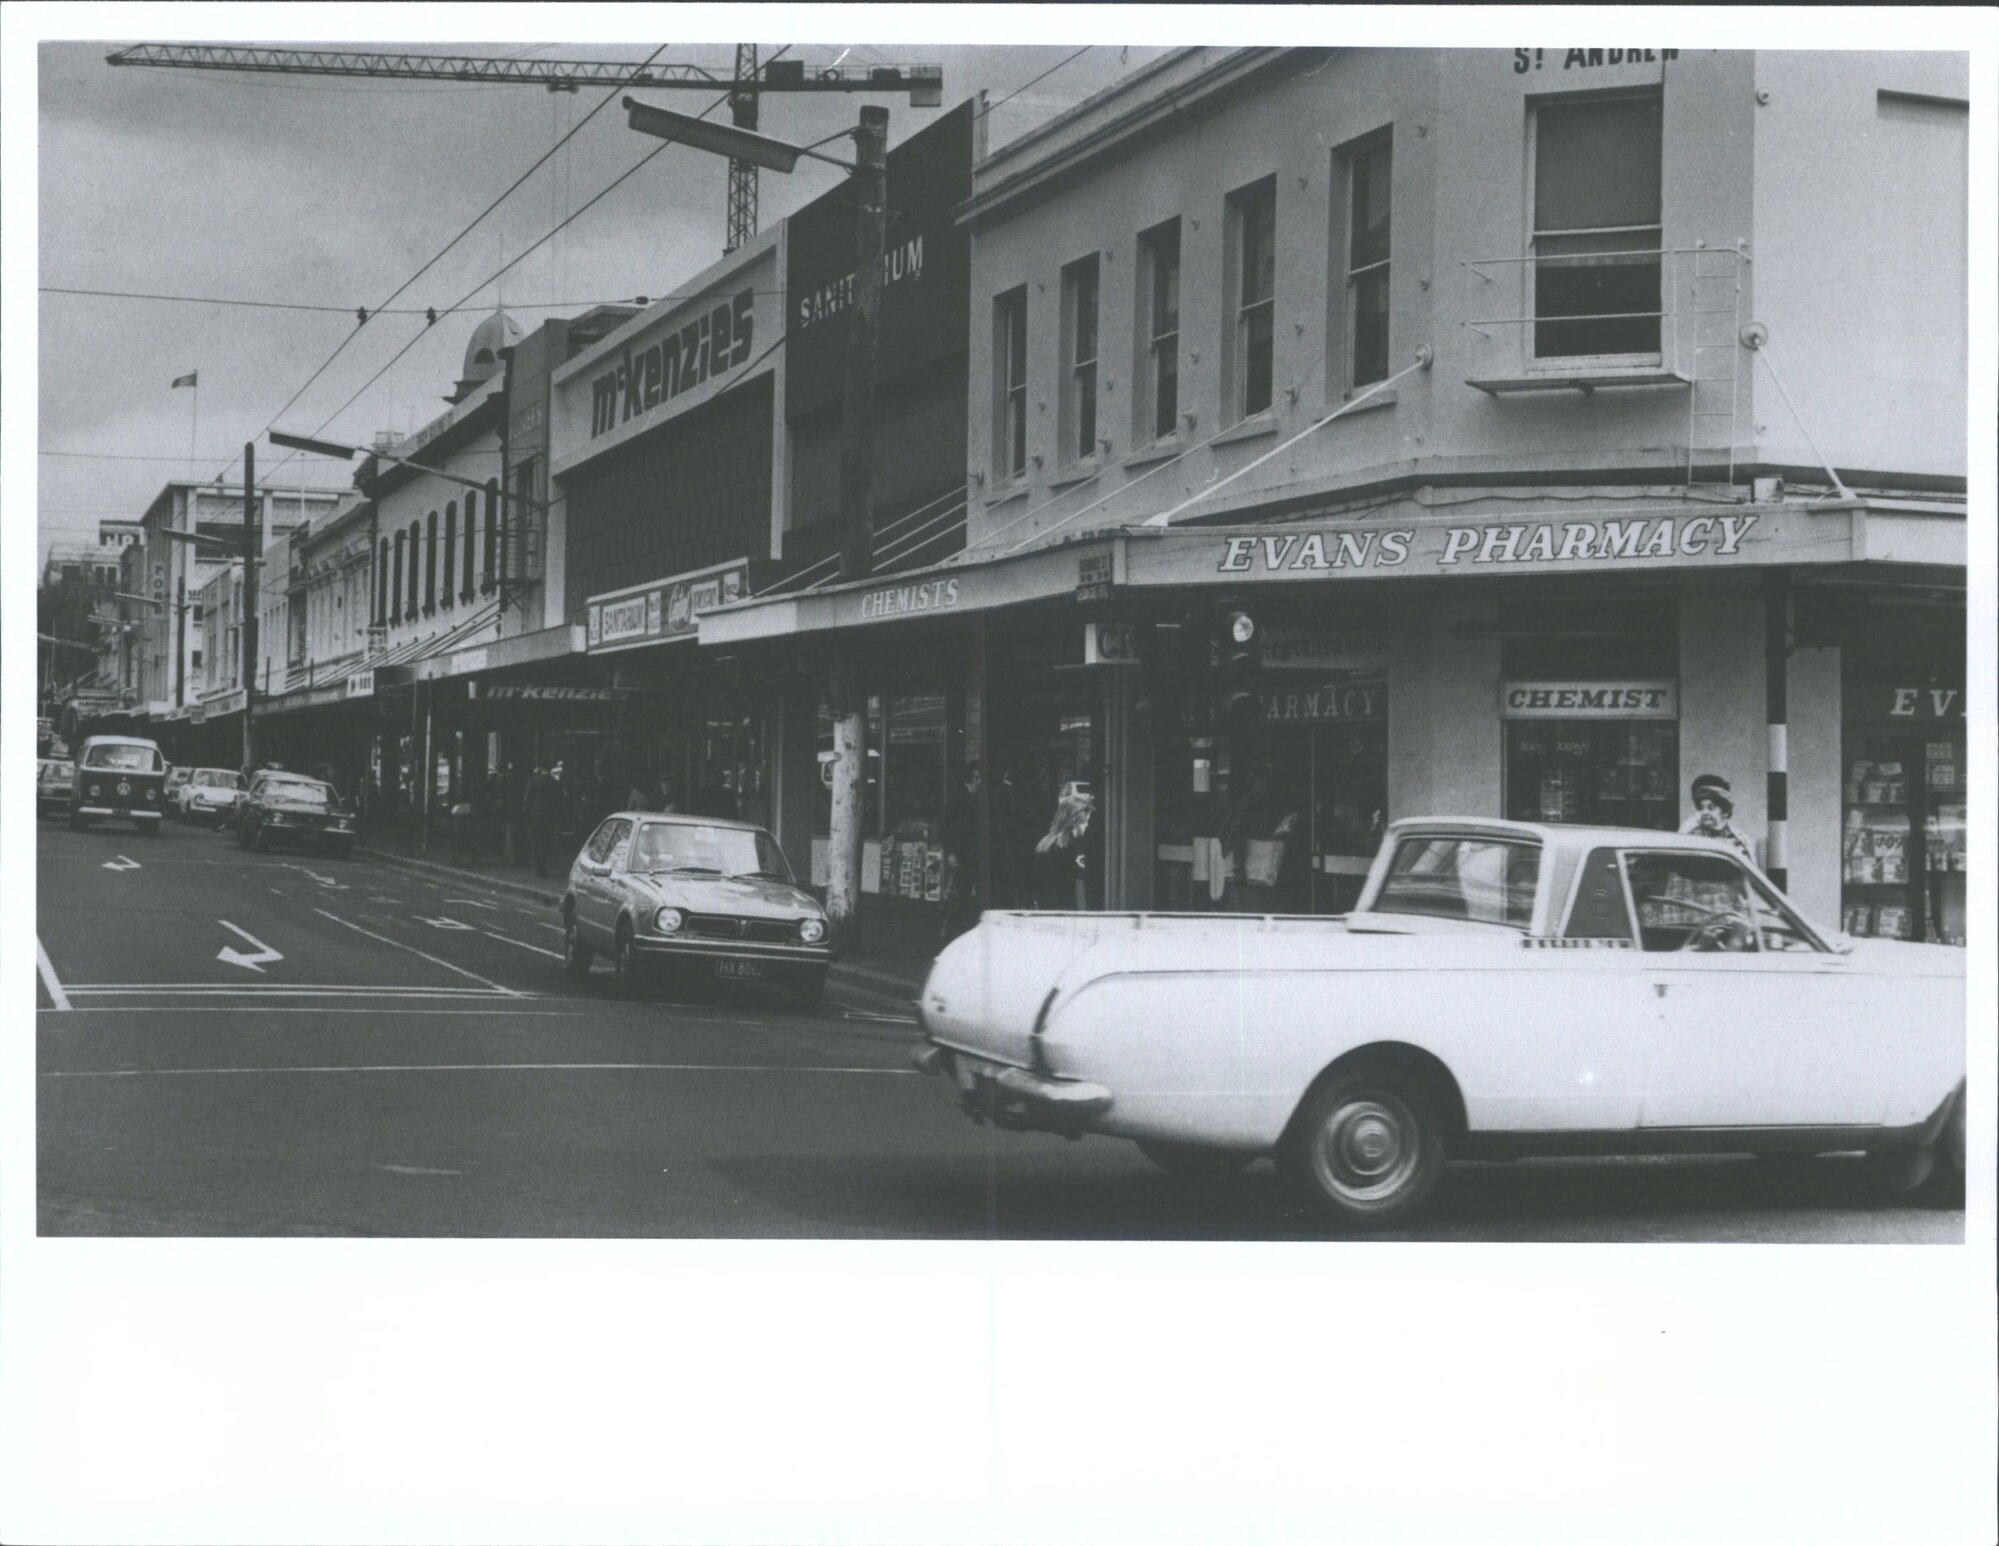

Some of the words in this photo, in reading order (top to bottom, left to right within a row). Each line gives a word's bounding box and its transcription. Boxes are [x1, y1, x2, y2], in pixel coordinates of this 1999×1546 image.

[800, 235, 924, 328] SANITIUM
[1217, 529, 1415, 573] EVANS
[1437, 514, 1760, 566] PHARMACY
[861, 577, 960, 620] CHEMISTS
[1259, 689, 1377, 719] ARMACY
[1508, 688, 1667, 710] CHEMIST
[1890, 688, 1967, 716] EV
